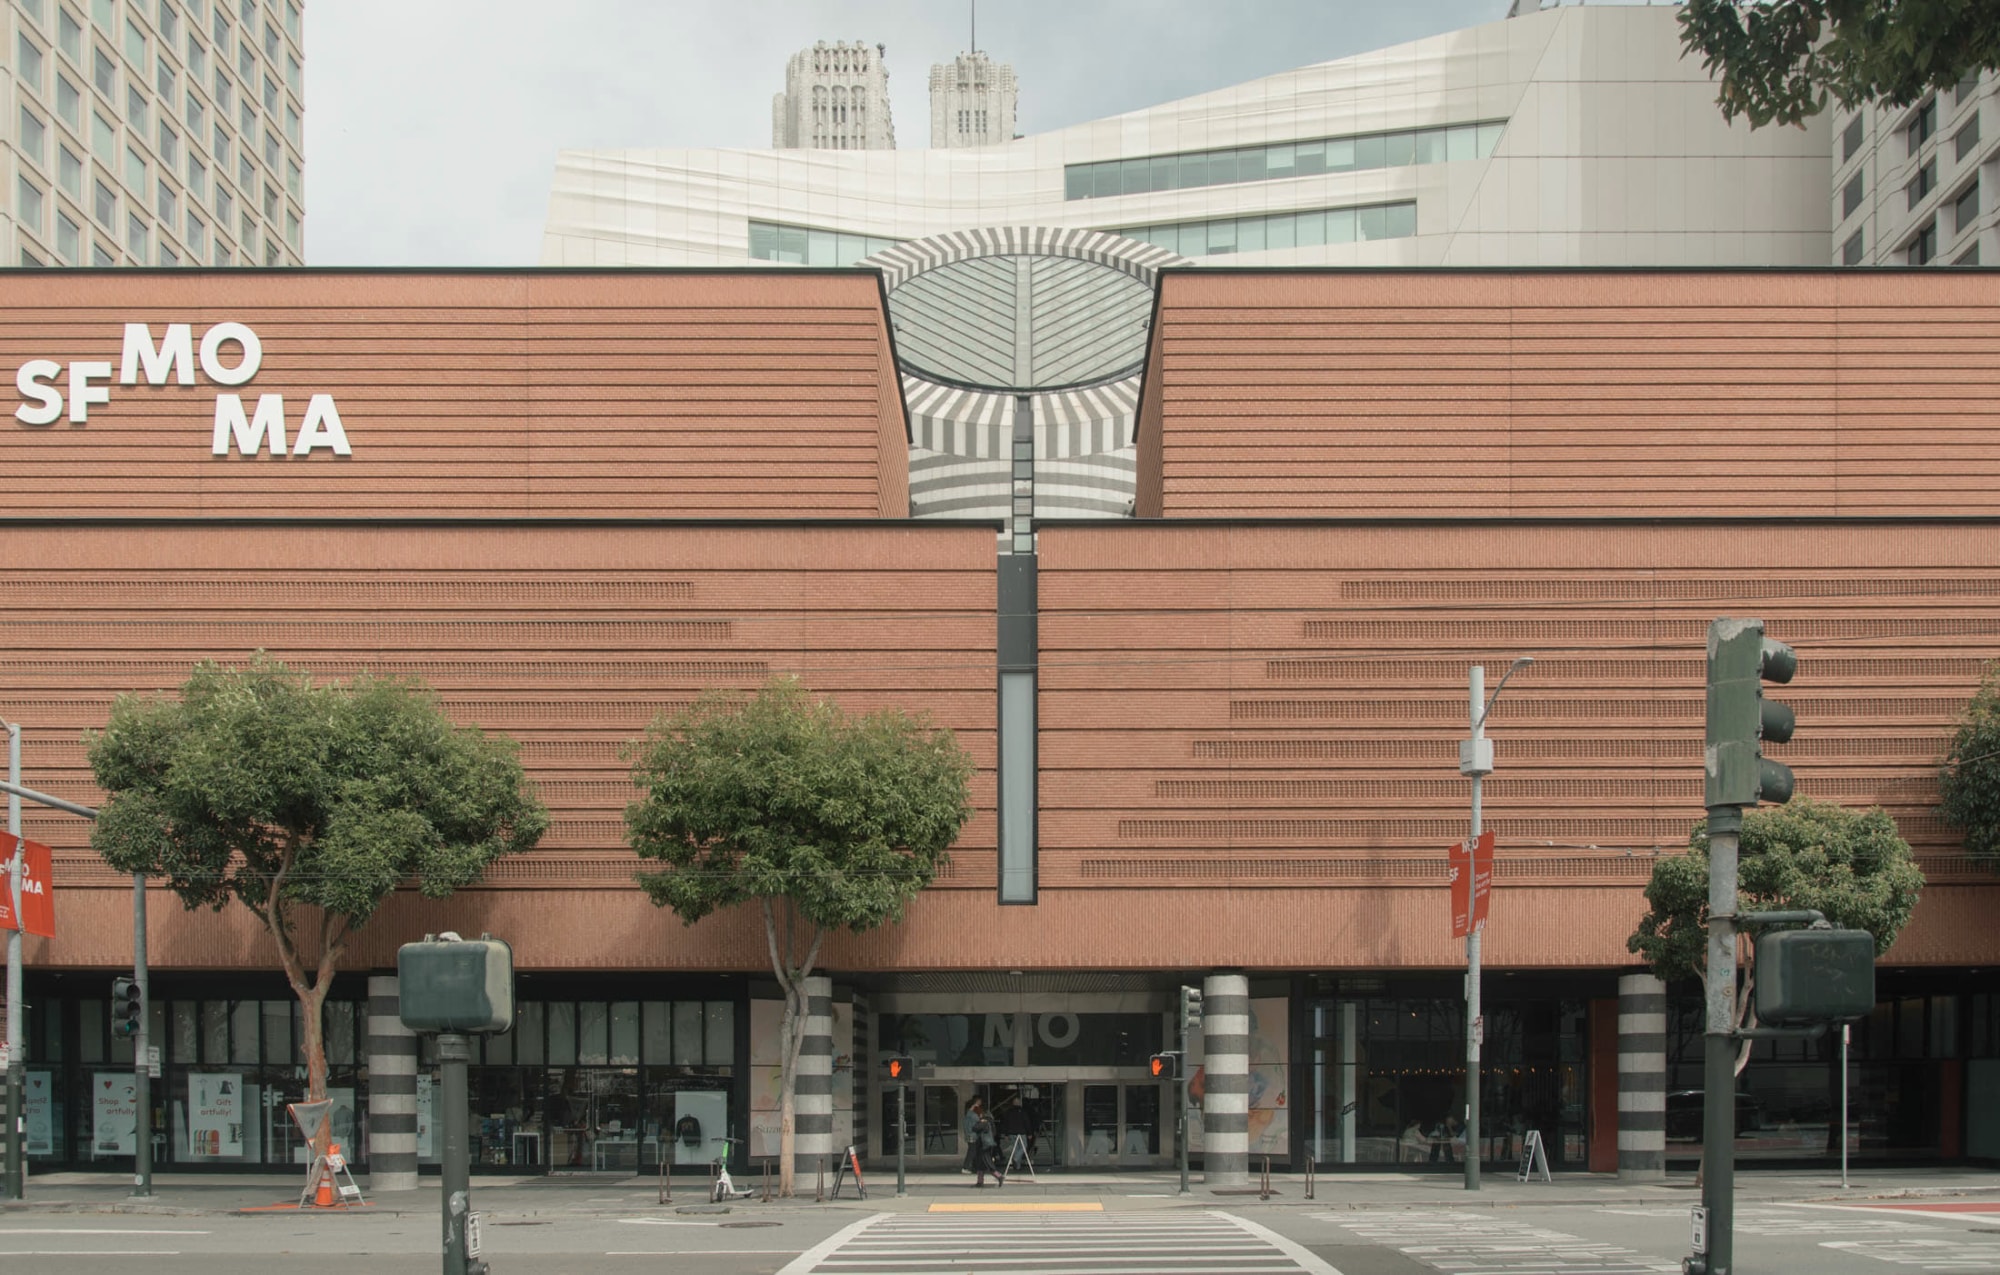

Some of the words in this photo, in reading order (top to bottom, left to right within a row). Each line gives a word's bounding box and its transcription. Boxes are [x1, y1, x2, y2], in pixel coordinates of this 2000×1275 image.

[120, 322, 262, 385] MO
[15, 359, 112, 424] SF
[212, 394, 352, 455] MA
[1449, 867, 1459, 883] SF
[22, 878, 43, 895] MA
[983, 1013, 1080, 1048] MO
[98, 1097, 119, 1106] Shop
[262, 1091, 284, 1107] SF
[200, 1108, 232, 1117] artfully!
